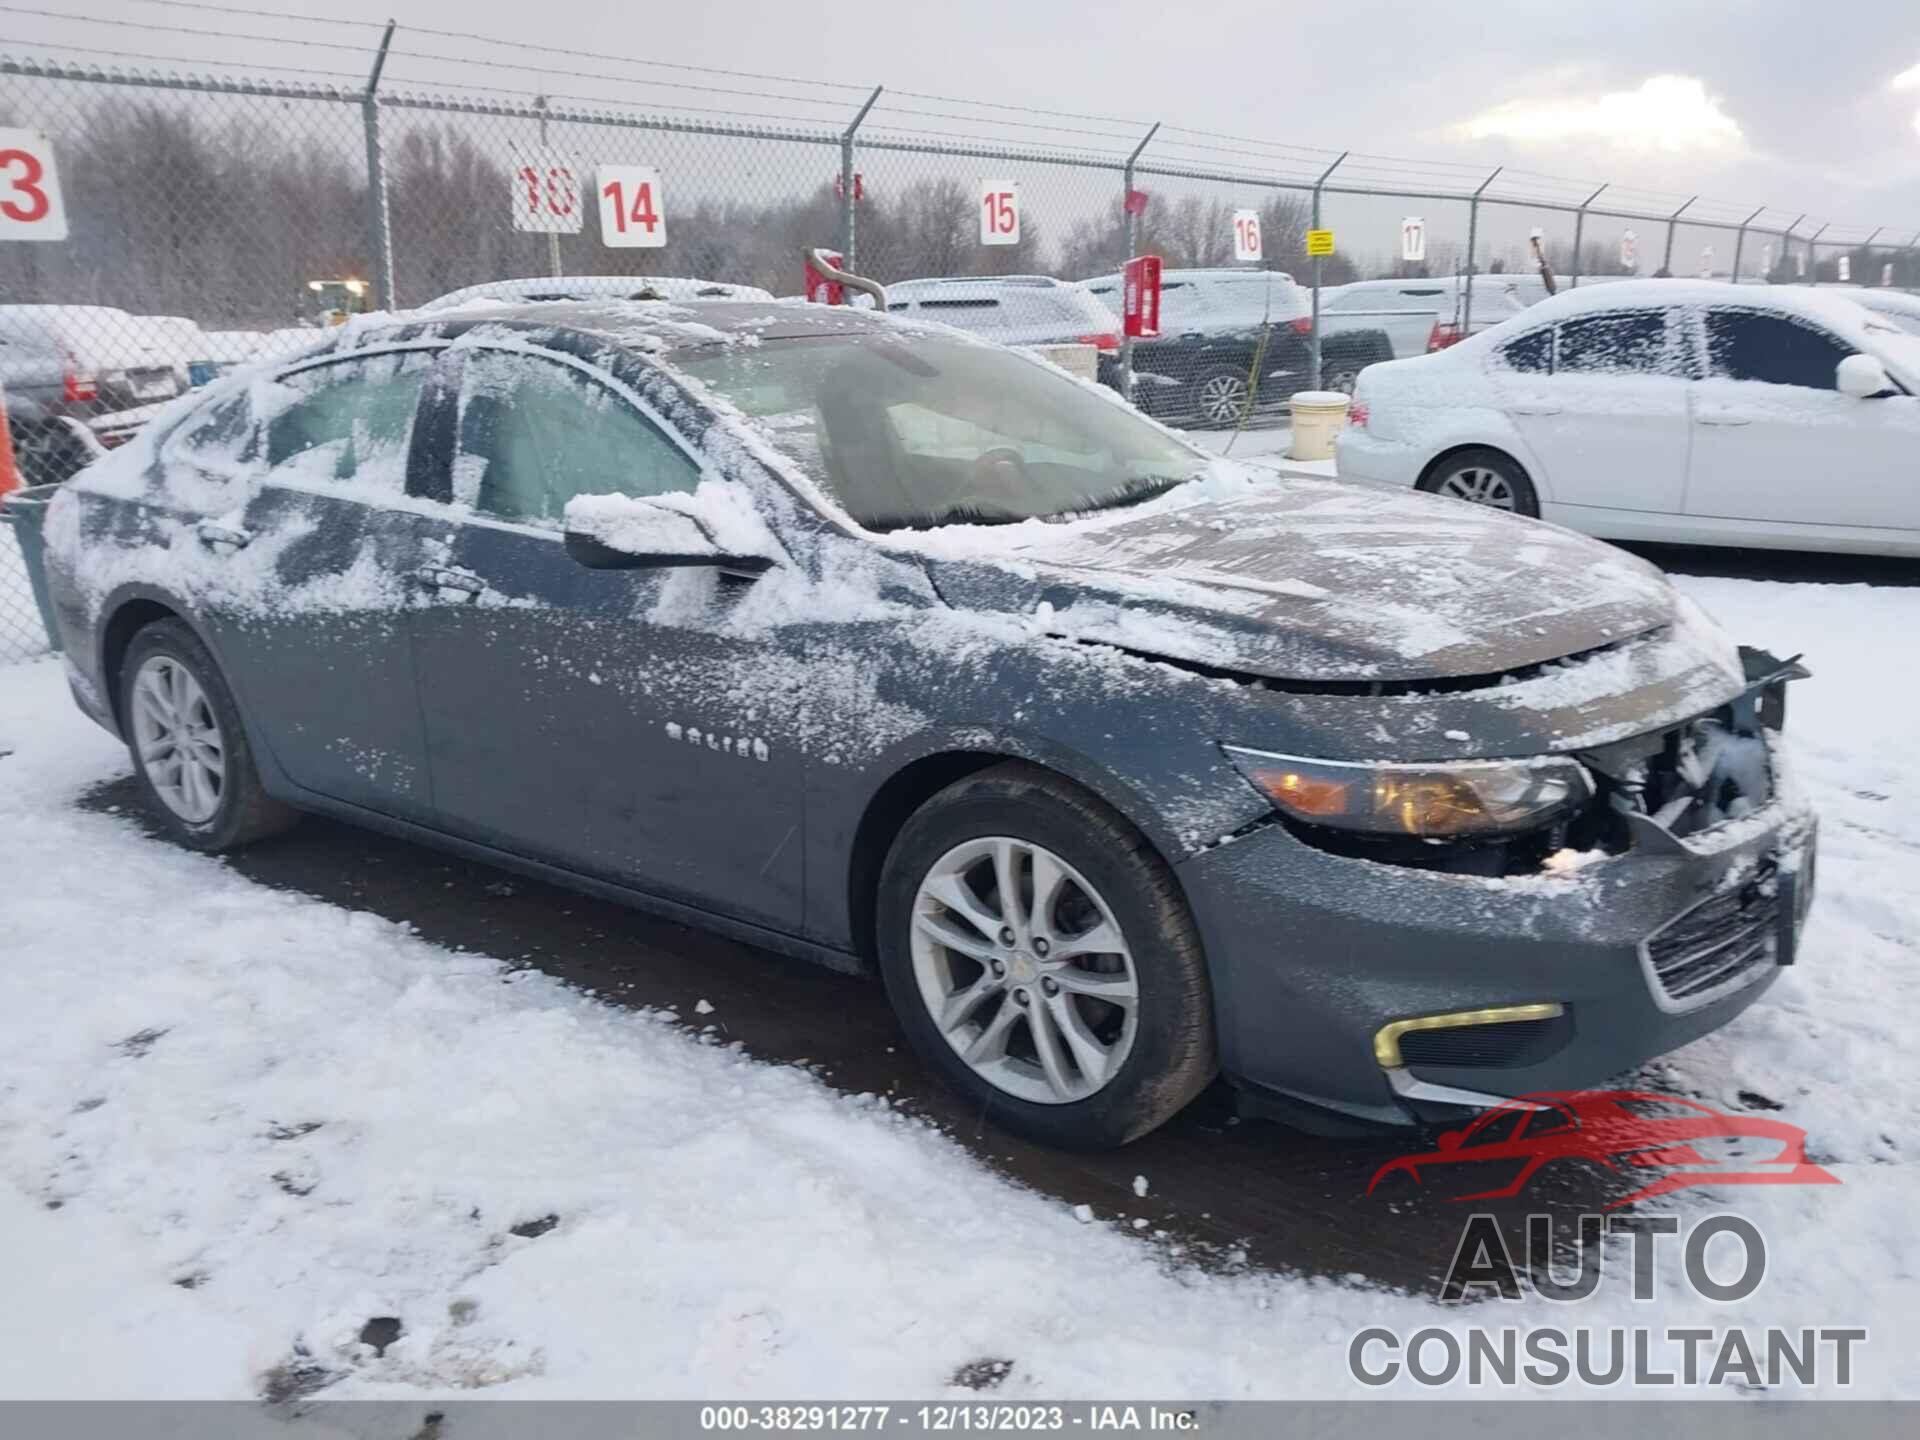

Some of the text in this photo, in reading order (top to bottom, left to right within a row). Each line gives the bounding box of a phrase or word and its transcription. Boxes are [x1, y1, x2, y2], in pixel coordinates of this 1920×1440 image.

[603, 181, 658, 233] 14
[984, 192, 1015, 233] 15
[1236, 219, 1258, 252] 16
[1404, 225, 1421, 252] 17
